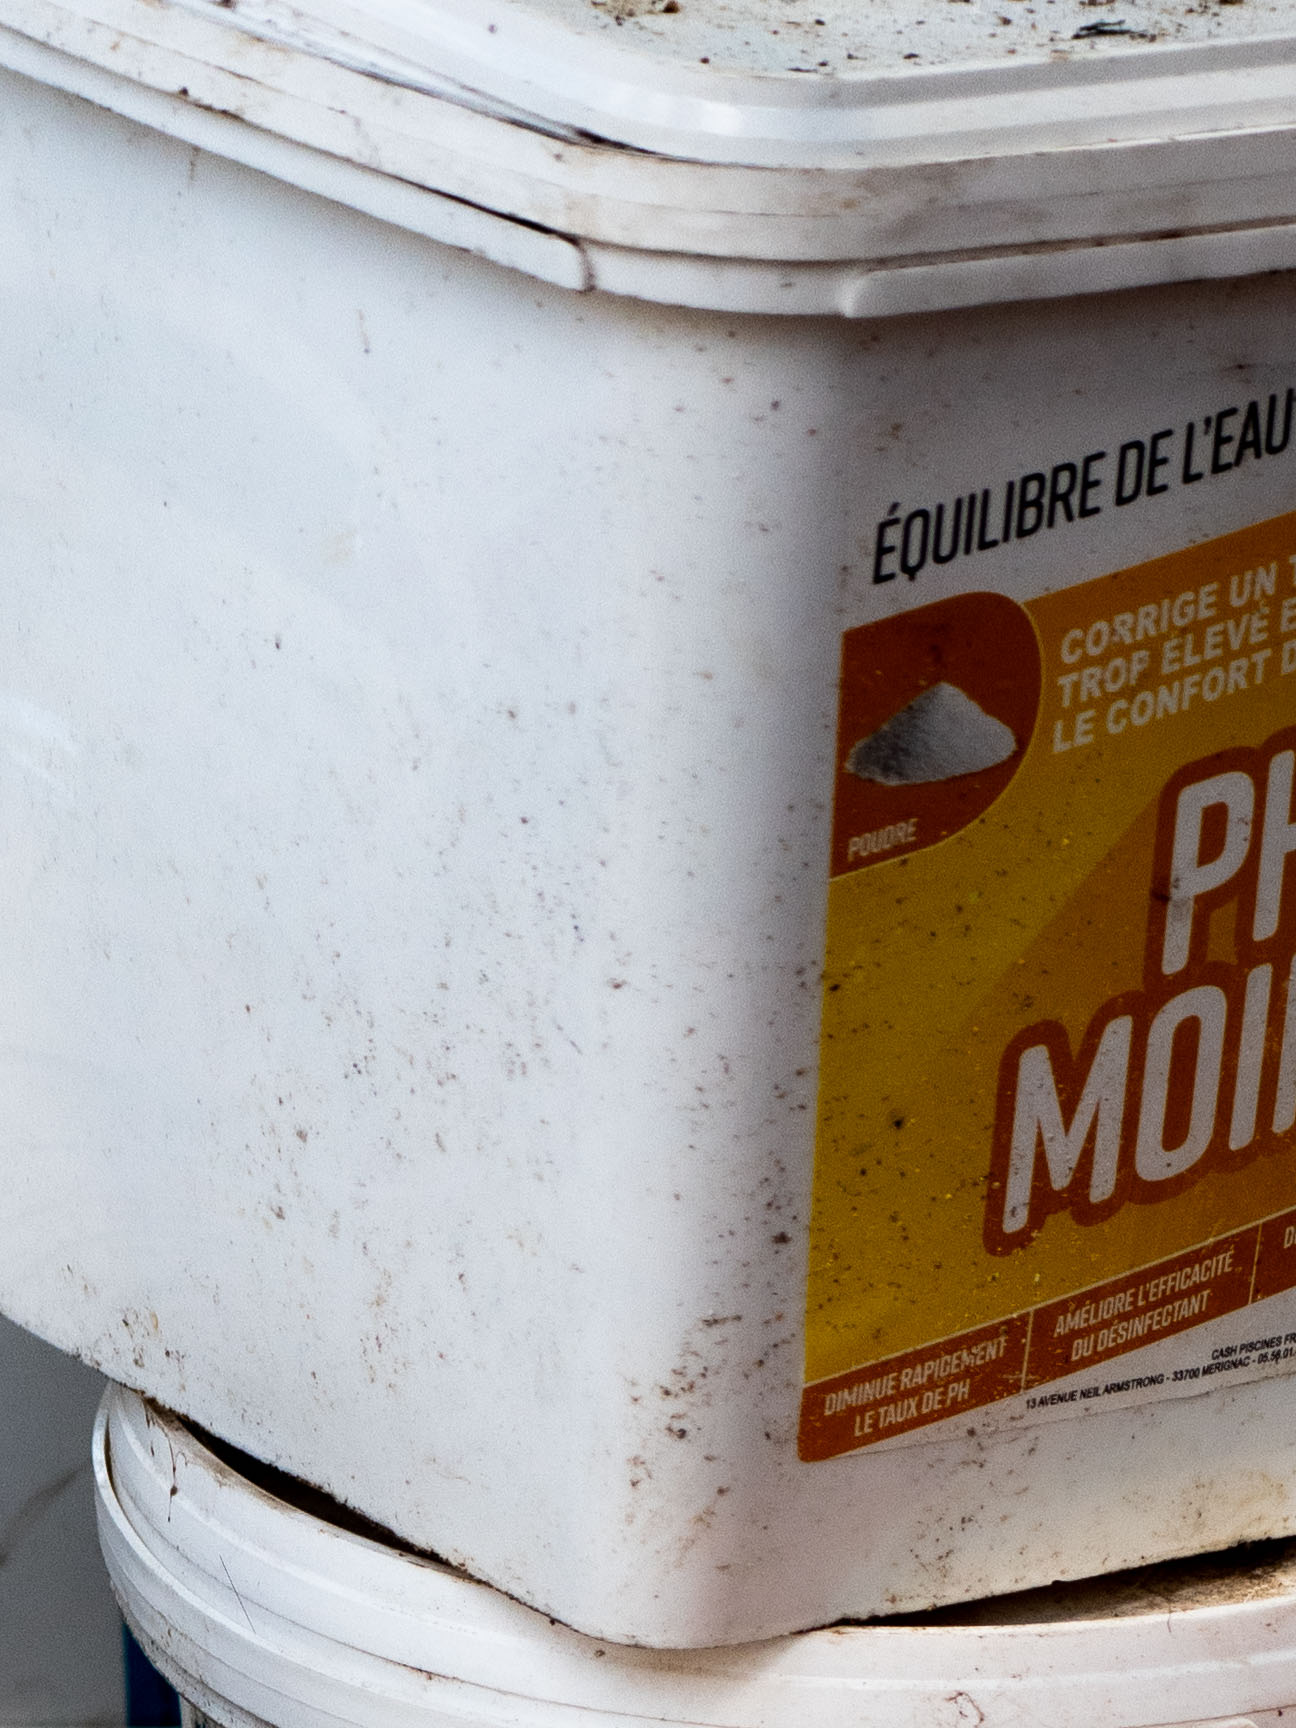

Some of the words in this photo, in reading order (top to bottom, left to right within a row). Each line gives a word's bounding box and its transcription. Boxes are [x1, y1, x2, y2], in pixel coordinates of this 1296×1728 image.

[873, 451, 1104, 585] ÉQUILIBRE
[1113, 435, 1171, 508] DE
[1060, 582, 1220, 665] CORRIGE
[1228, 563, 1277, 607] UN
[1053, 709, 1094, 753] LE
[1106, 652, 1271, 735] CONFORT
[1057, 650, 1150, 707] TROP
[847, 819, 918, 861] POUDRE
[1138, 1251, 1234, 1311] L'EFFICACITÉ
[1071, 1338, 1093, 1361] DU
[1097, 1290, 1211, 1354] DÉSINFECTANT
[824, 1378, 902, 1416] DIMINUE
[854, 1413, 875, 1437] LE
[878, 1397, 918, 1429] TAUX
[922, 1390, 943, 1415] DE
[946, 1380, 970, 1407] PH
